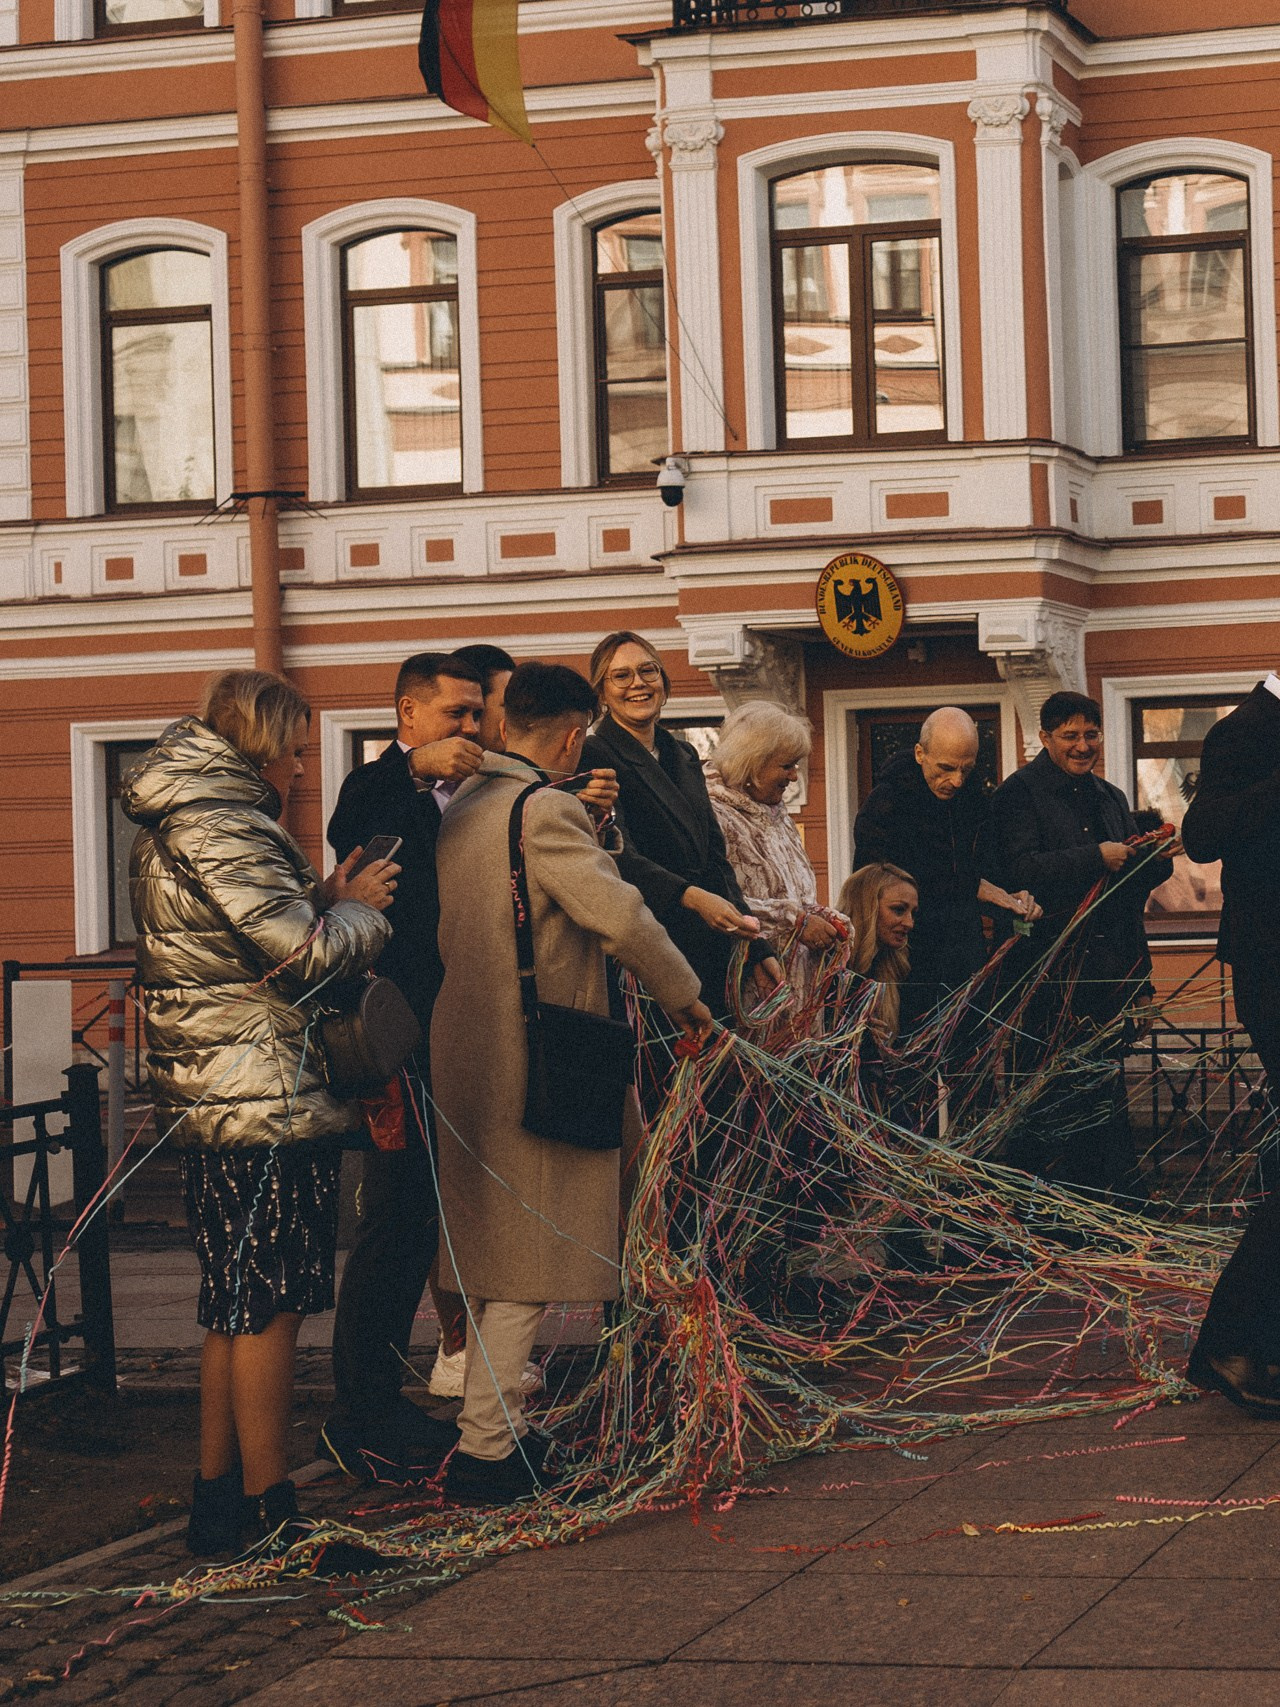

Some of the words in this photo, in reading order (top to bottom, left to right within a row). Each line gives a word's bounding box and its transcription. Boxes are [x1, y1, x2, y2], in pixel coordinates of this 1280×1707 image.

[818, 556, 859, 614] BUNDESREPUBLIK
[861, 557, 902, 611] DEUTSCHLAND
[832, 634, 894, 657] GENERALKONSULAT
